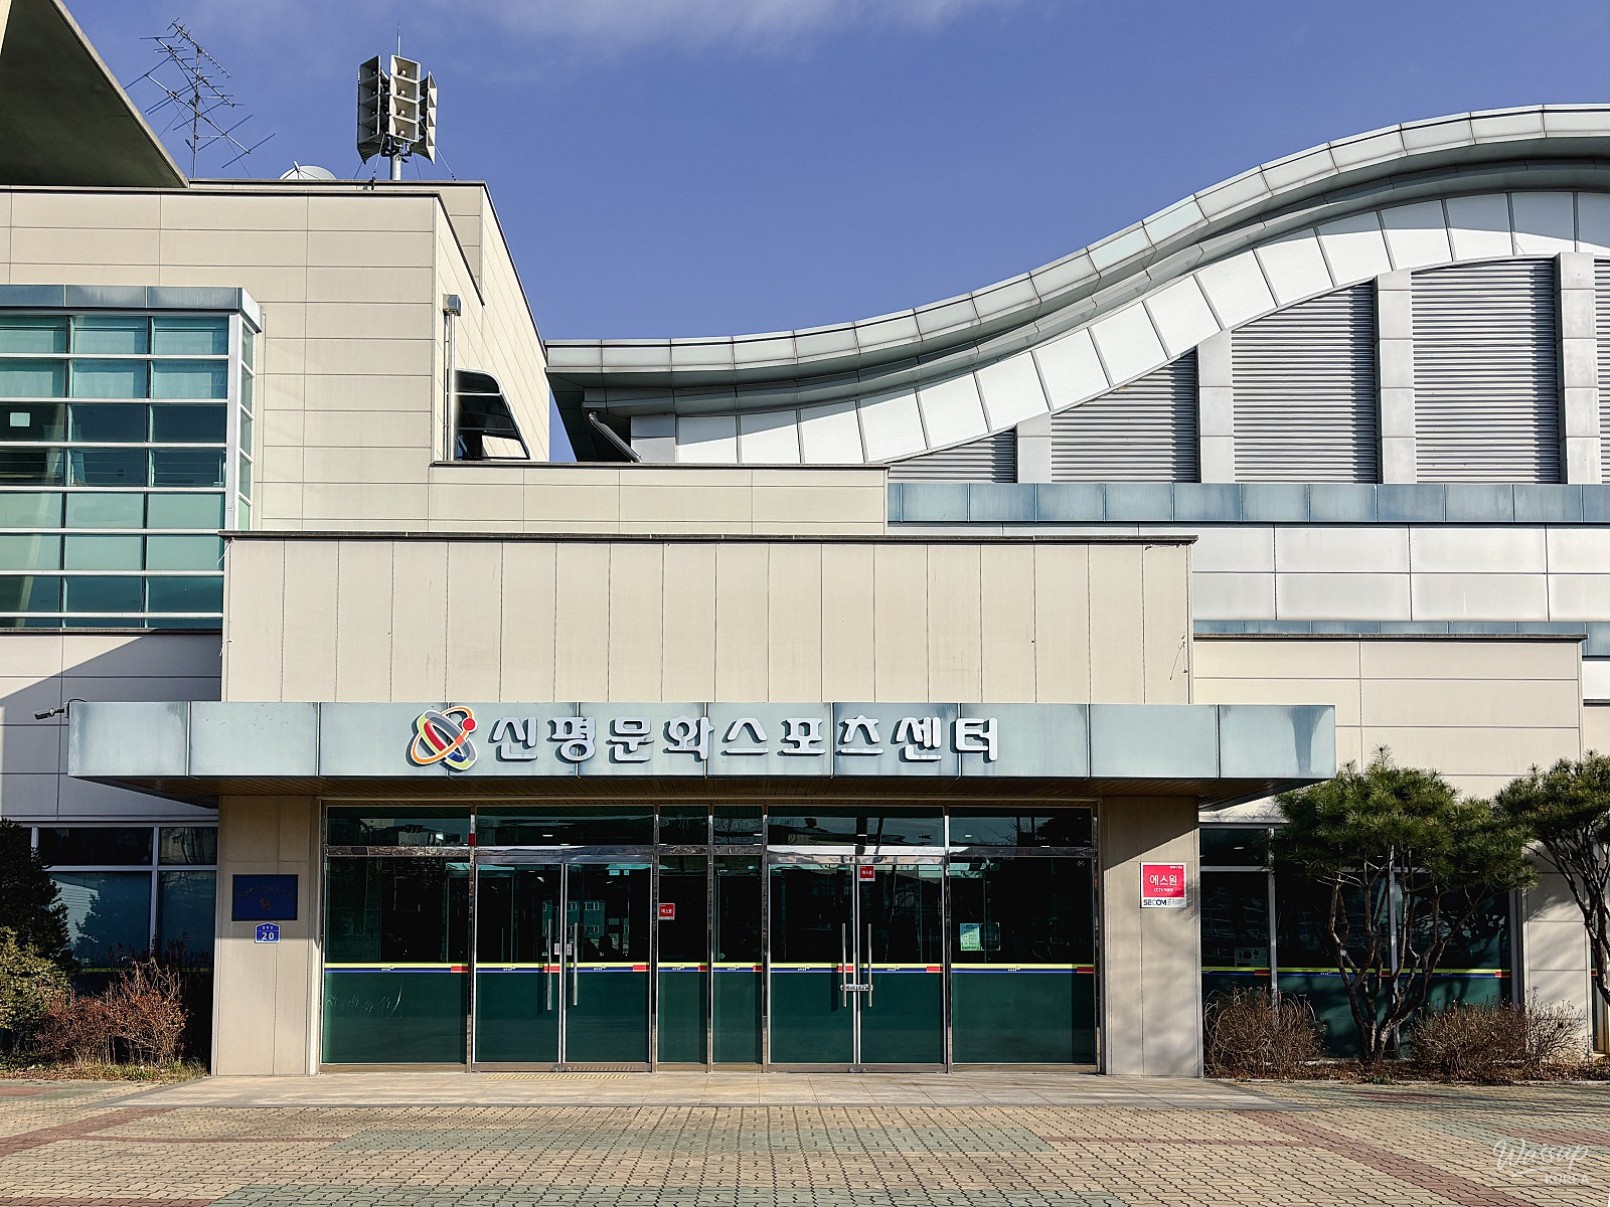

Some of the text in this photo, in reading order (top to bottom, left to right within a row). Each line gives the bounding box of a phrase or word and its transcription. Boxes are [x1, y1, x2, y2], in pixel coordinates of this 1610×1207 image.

[490, 714, 998, 762] 신평문화스포츠센터
[1149, 874, 1178, 886] 에스원
[261, 931, 275, 941] 20
